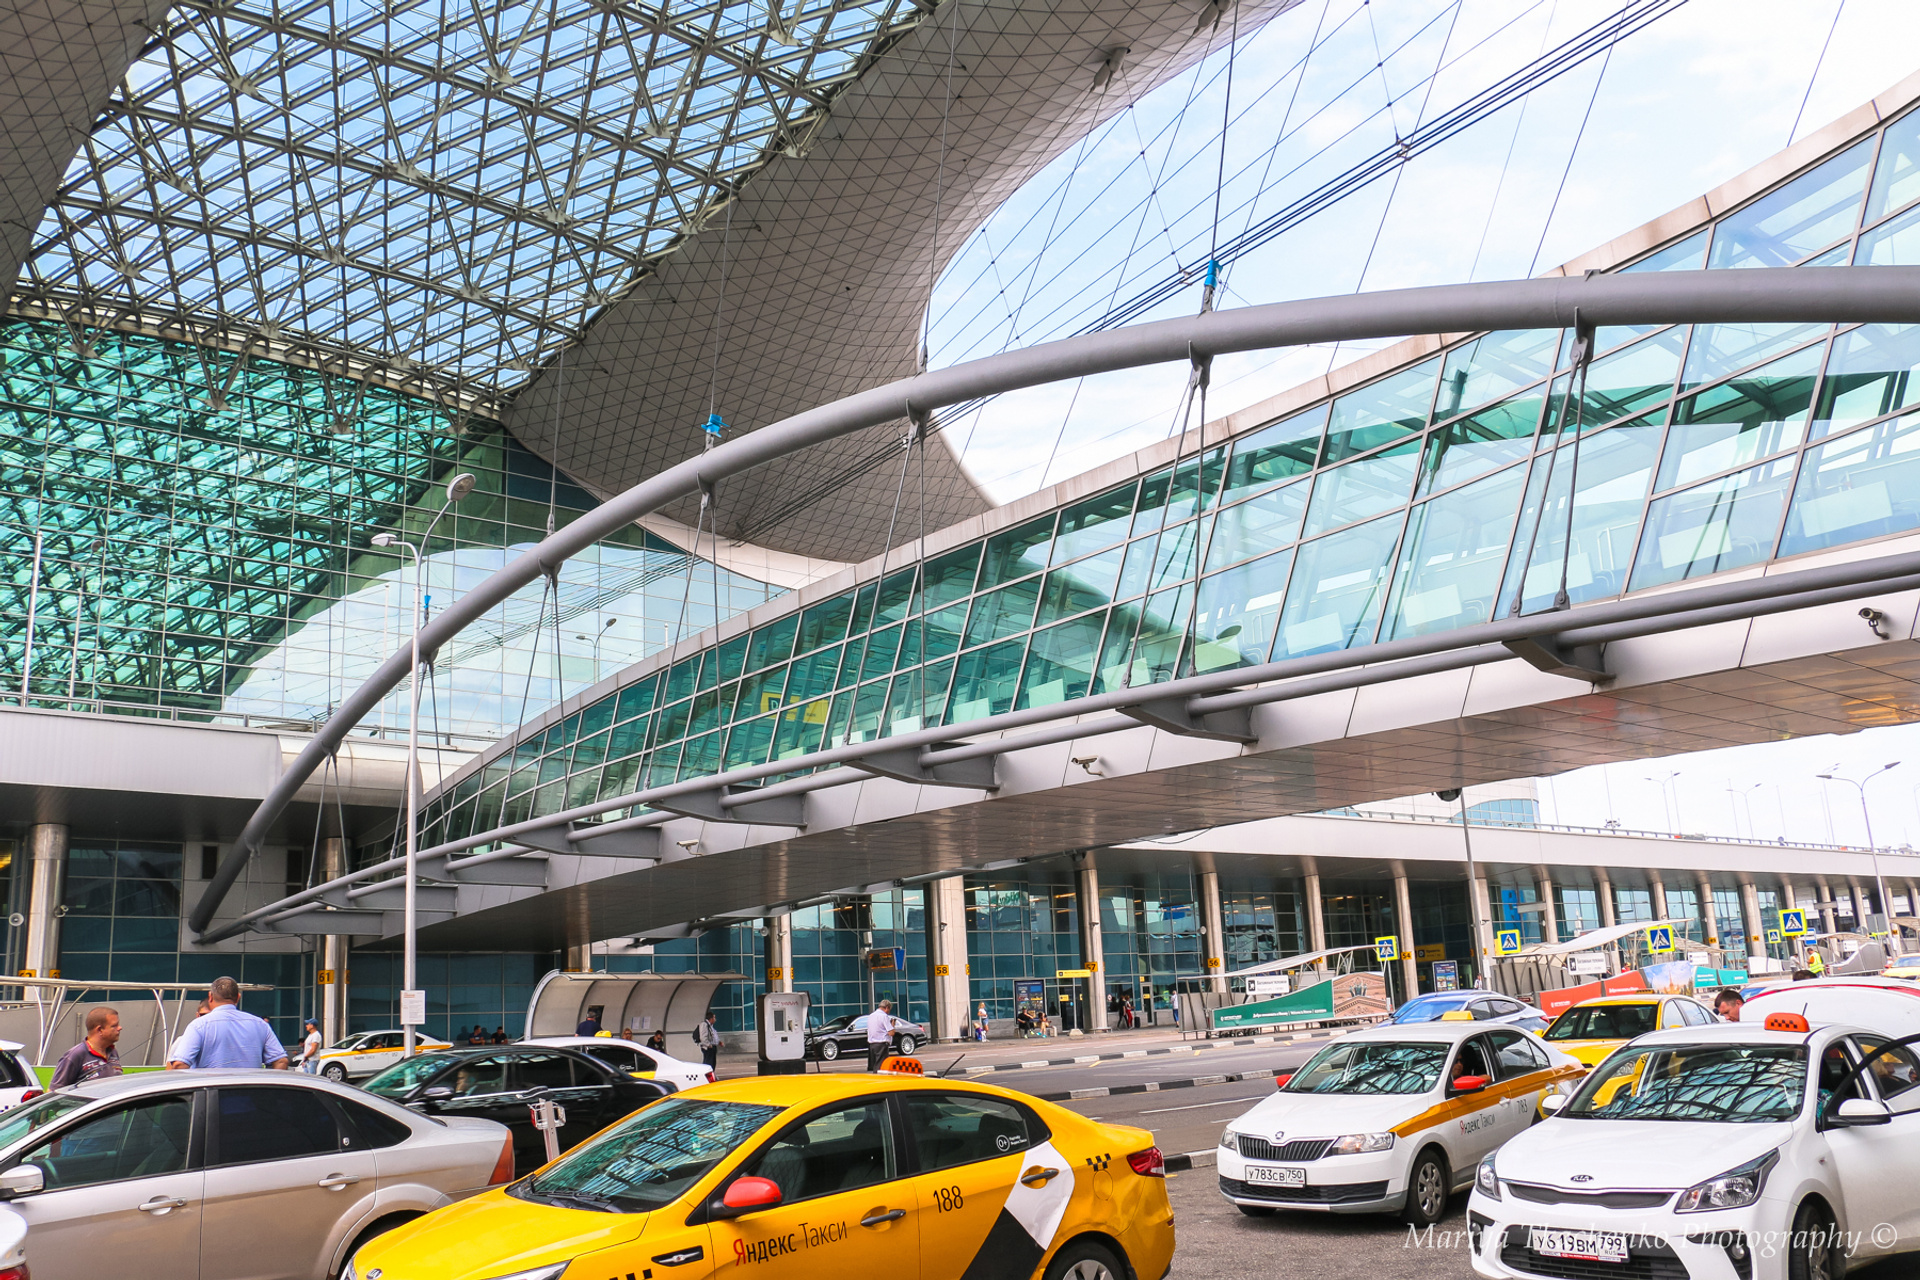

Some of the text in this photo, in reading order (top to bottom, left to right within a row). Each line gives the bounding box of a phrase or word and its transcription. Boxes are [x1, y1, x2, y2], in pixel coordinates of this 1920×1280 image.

[771, 700, 779, 710] D
[1402, 951, 1411, 959] 54
[1209, 959, 1219, 967] 56
[769, 969, 781, 978] 59
[936, 965, 948, 975] 58
[319, 972, 331, 982] 61
[1517, 1099, 1528, 1115] 783
[1460, 1113, 1496, 1135] Яндекс Такси
[1287, 1169, 1302, 1179] 750
[933, 1185, 964, 1214] 188
[733, 1221, 848, 1267] Яндекс Такси
[1600, 1236, 1622, 1250] 799
